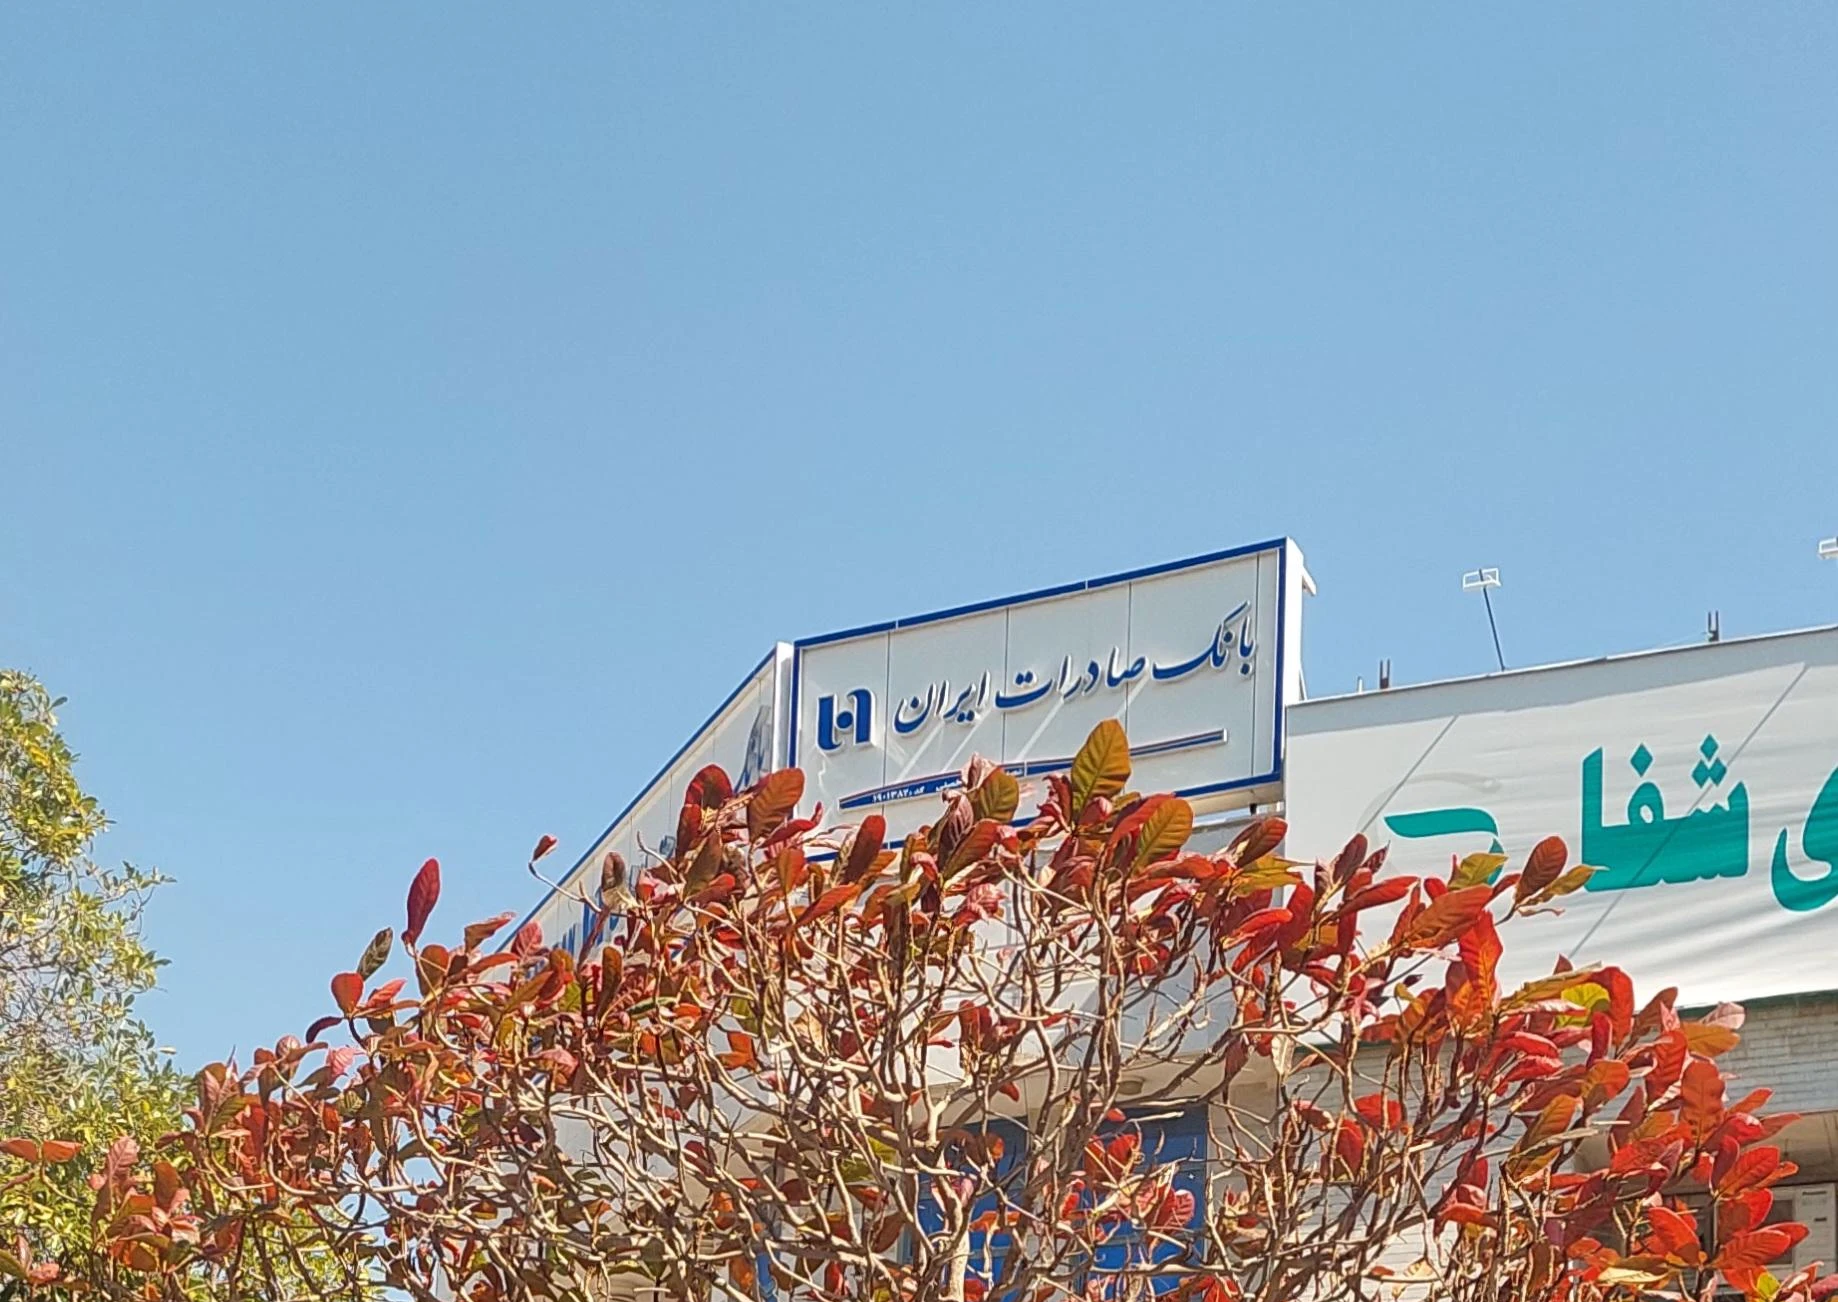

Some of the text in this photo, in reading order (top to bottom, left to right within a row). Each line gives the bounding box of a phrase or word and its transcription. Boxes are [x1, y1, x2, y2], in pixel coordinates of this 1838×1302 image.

[894, 600, 1257, 734] بانک صادرات ایران
[1581, 733, 1751, 892] شفا
